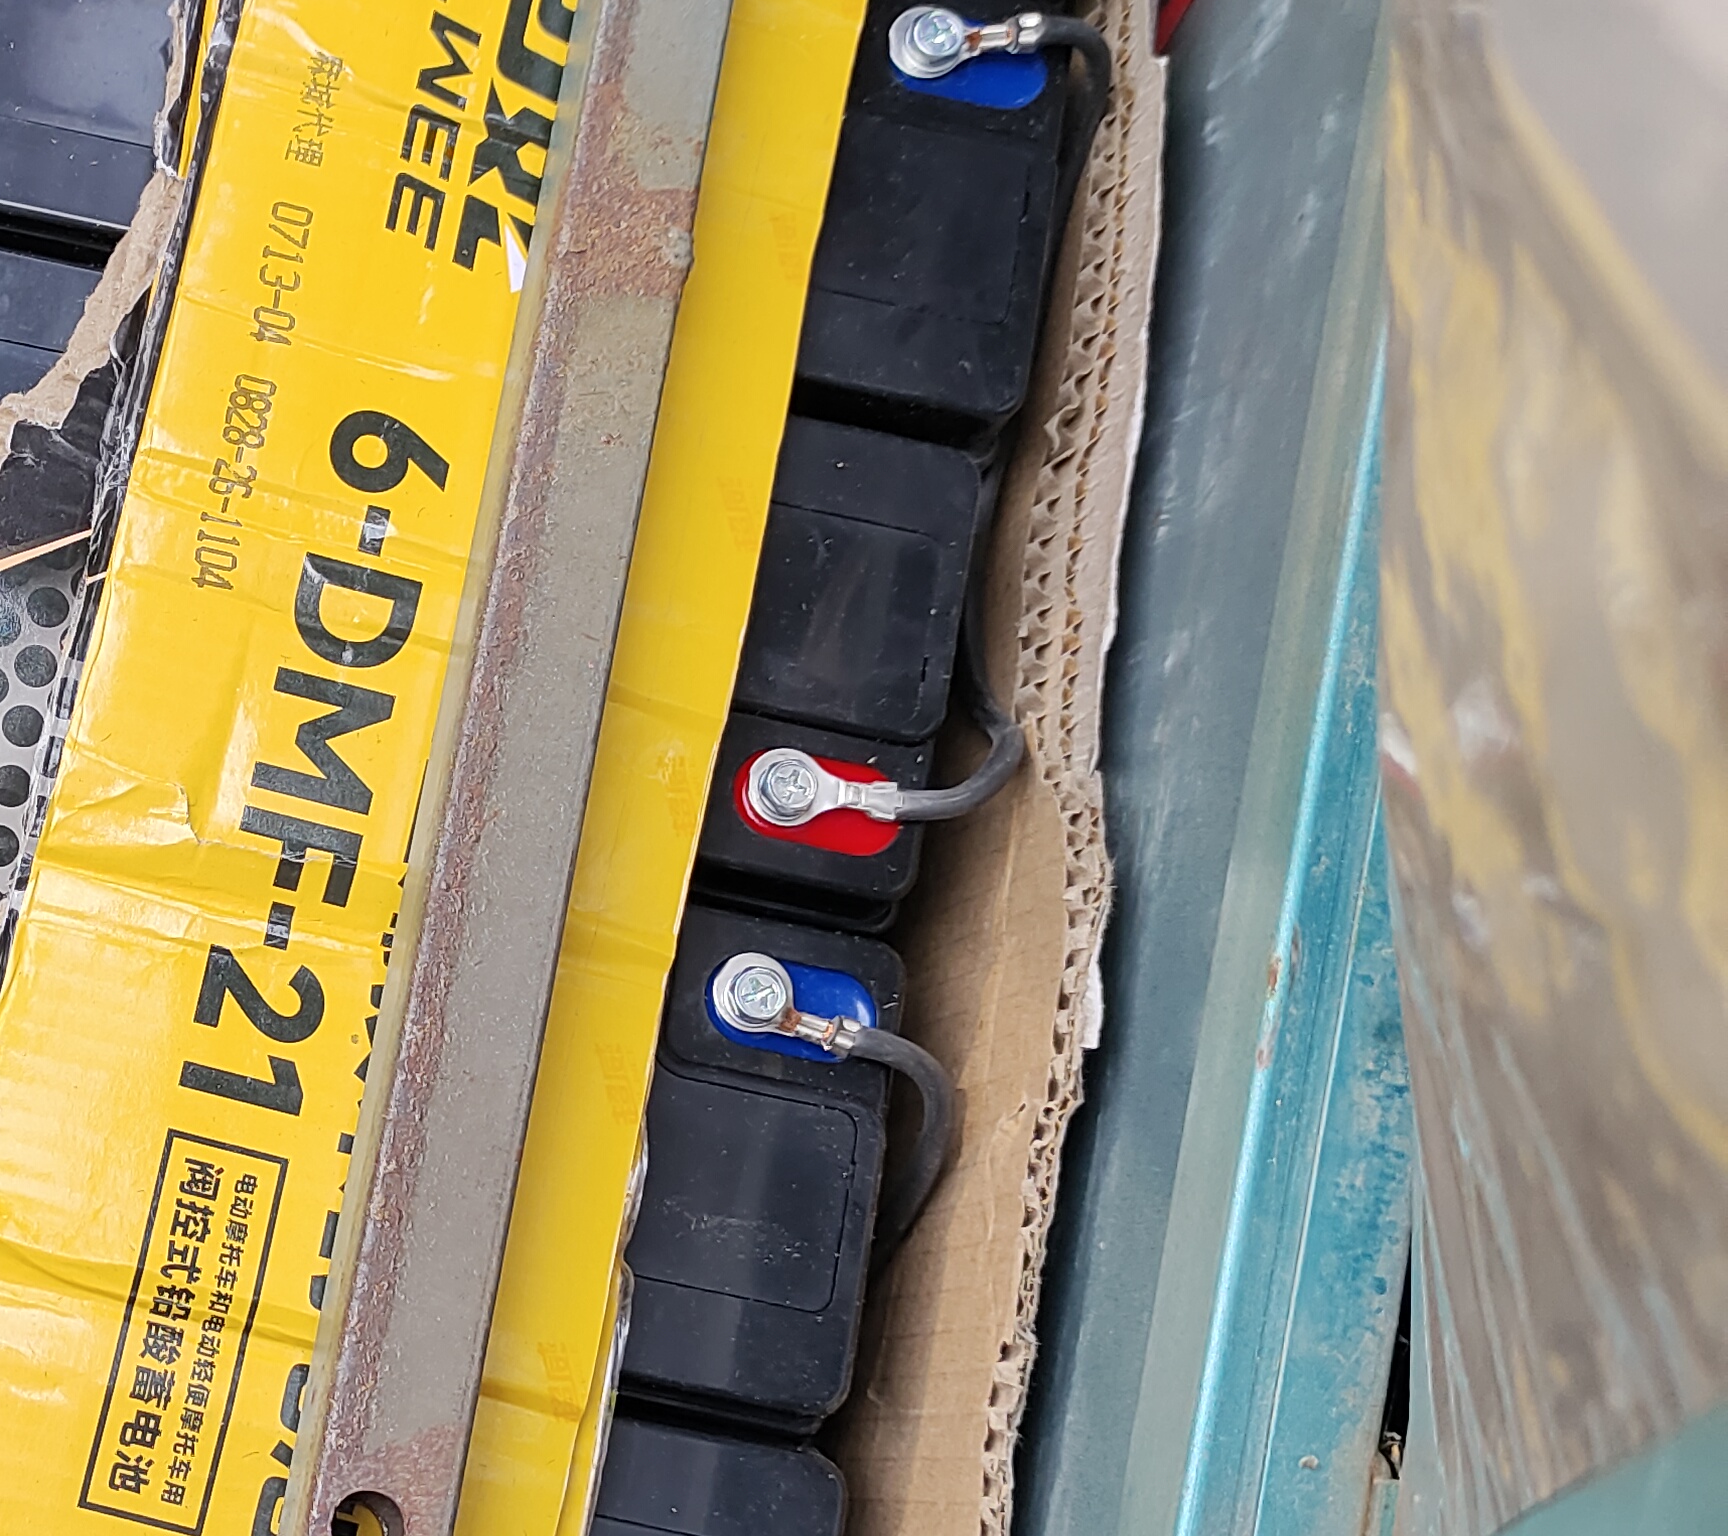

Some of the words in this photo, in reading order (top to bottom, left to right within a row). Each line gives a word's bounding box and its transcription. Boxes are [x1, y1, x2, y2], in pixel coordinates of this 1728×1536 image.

[249, 200, 315, 348] 0713-04
[190, 372, 278, 591] 0828-26-1104
[178, 409, 450, 1117] 6-DMF-21
[107, 1156, 224, 1496] 阀控式铅酸蓄电池
[160, 1172, 260, 1507] 电动摩托车和电动轻便摩托车用
